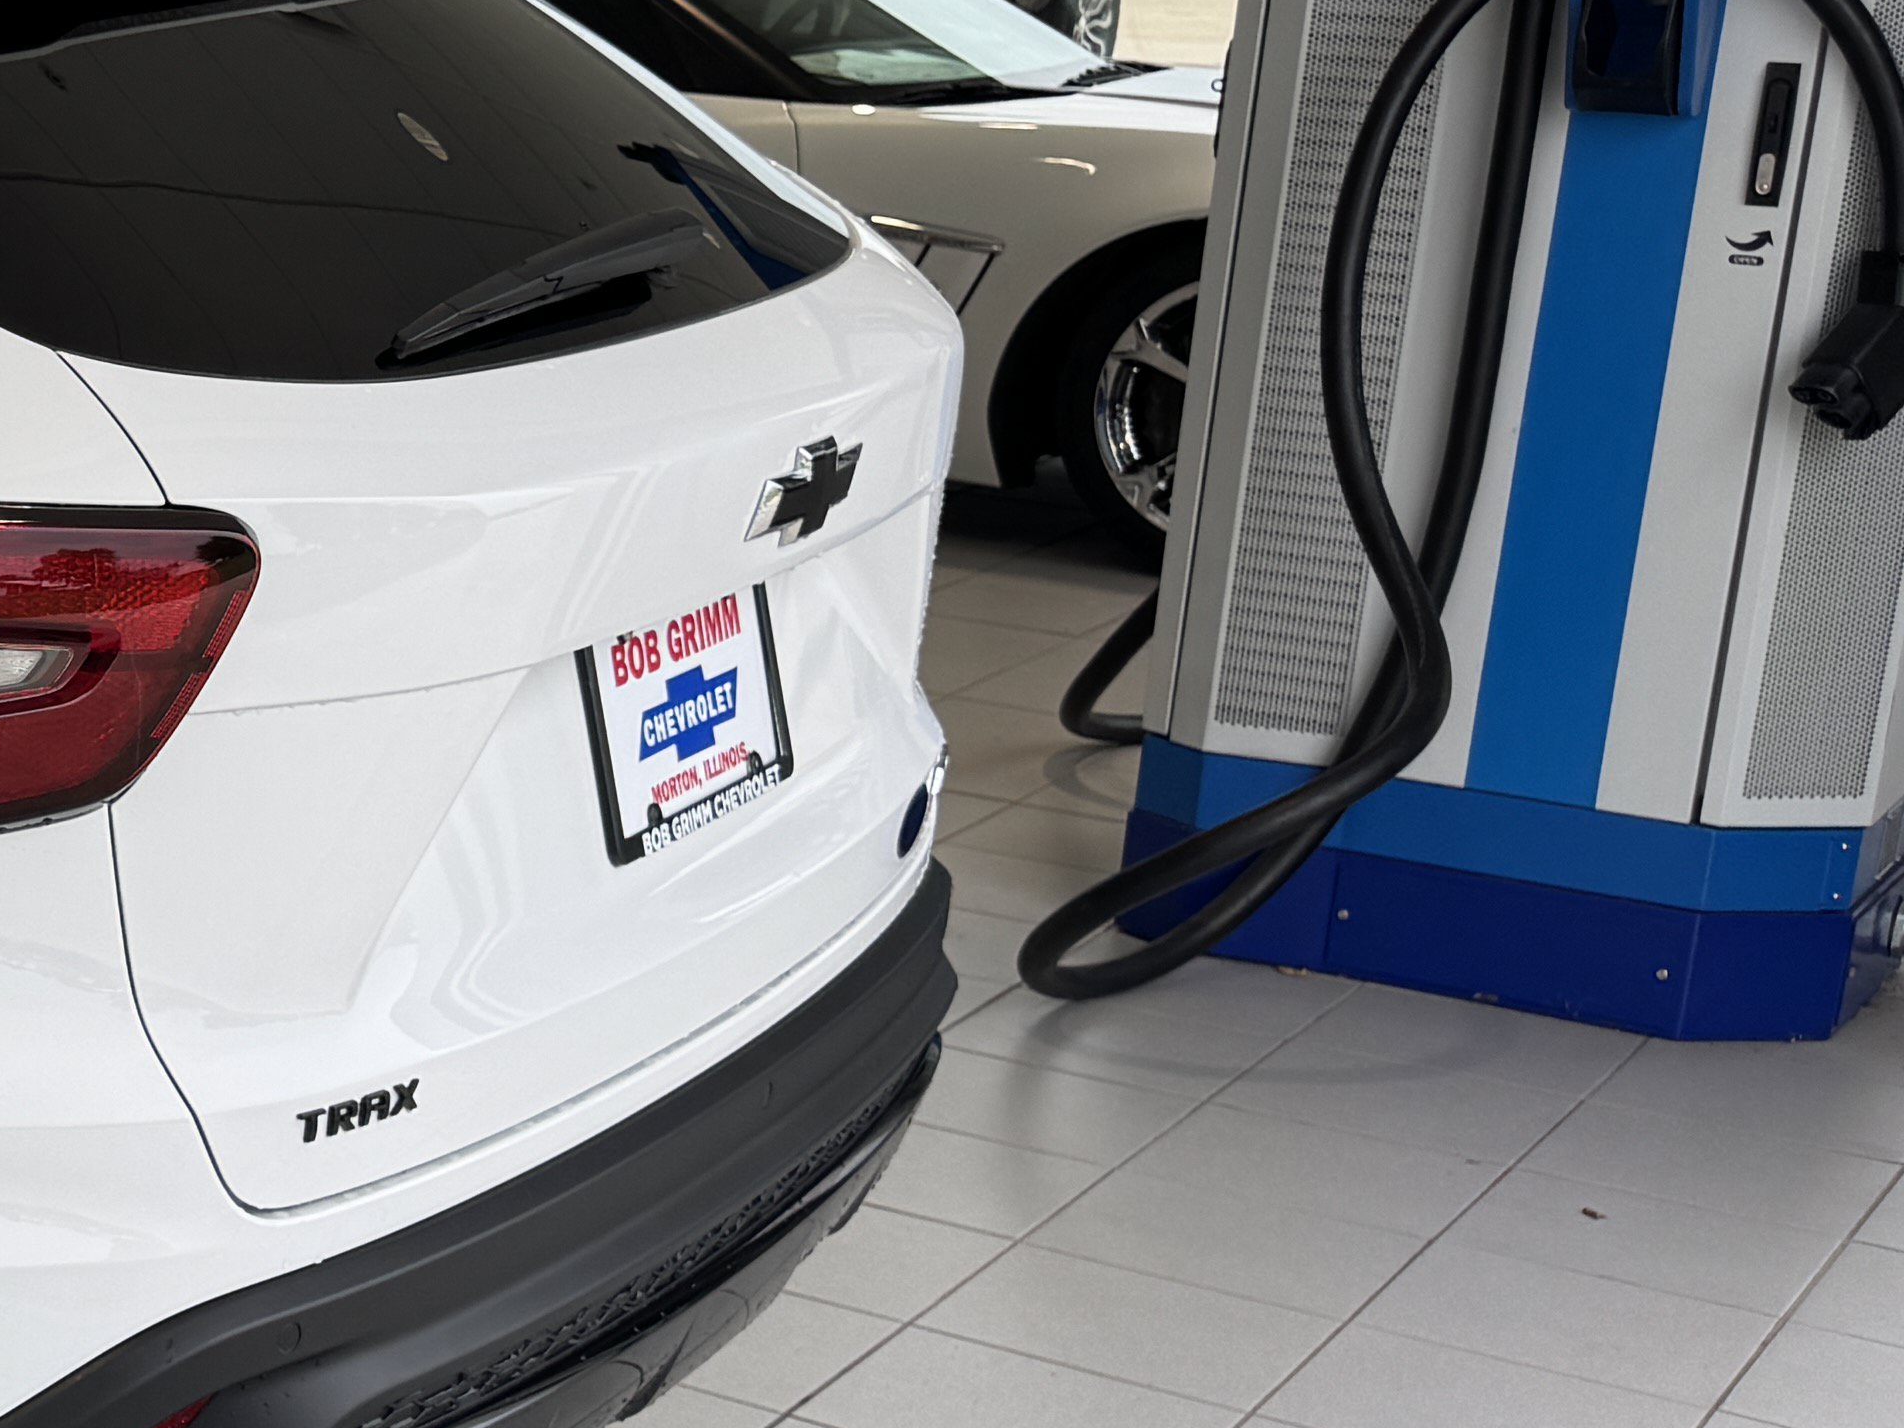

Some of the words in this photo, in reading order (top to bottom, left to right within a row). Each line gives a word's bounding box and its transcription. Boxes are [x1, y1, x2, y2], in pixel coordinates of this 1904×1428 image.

[610, 628, 661, 688] BOB
[666, 592, 742, 663] GRIMM
[642, 681, 735, 748] CHEVROLET
[641, 822, 671, 857] BOB
[671, 799, 713, 841] GRIMM
[713, 763, 782, 820] CHEVROLET
[651, 765, 703, 805] MORTON,
[295, 1077, 420, 1144] TRAX
